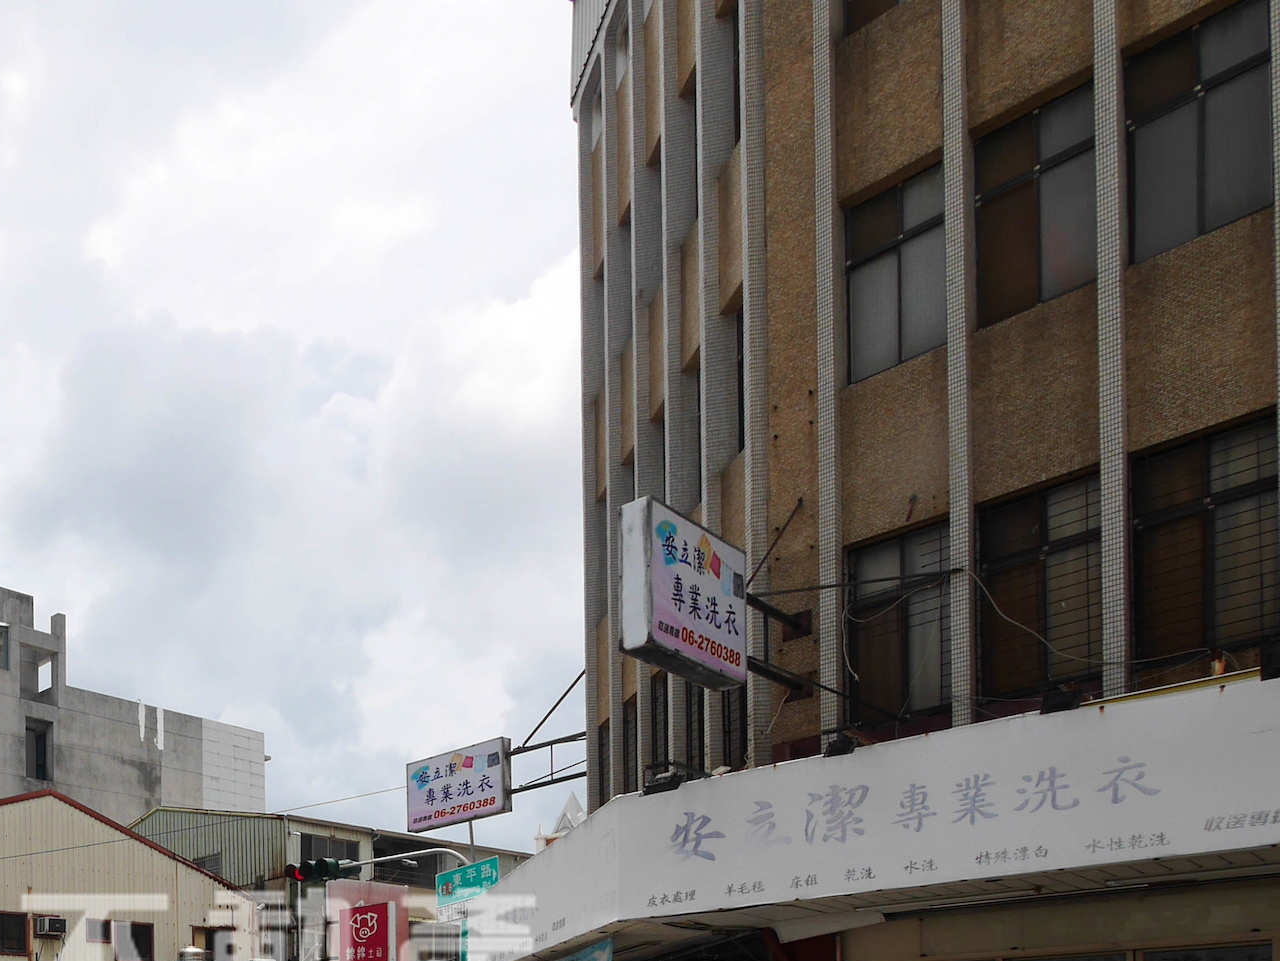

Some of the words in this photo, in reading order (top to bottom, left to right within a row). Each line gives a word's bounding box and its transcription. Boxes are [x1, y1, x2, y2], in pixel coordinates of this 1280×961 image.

[662, 531, 705, 576] 安立潔
[671, 574, 739, 636] 專業洗衣
[681, 627, 741, 667] 06-2760388
[416, 763, 457, 784] 安立潔
[425, 775, 494, 806] 專業洗衣
[434, 796, 496, 819] 06-2760388
[670, 756, 1161, 861] 安立潔專業洗衣
[452, 863, 492, 887] 東平路
[647, 889, 696, 908] 皮衣處理
[844, 867, 876, 882] 乾洗
[904, 859, 938, 874] 水洗
[975, 845, 1049, 866] 特殊漂白
[1085, 832, 1170, 854] 水性乾洗
